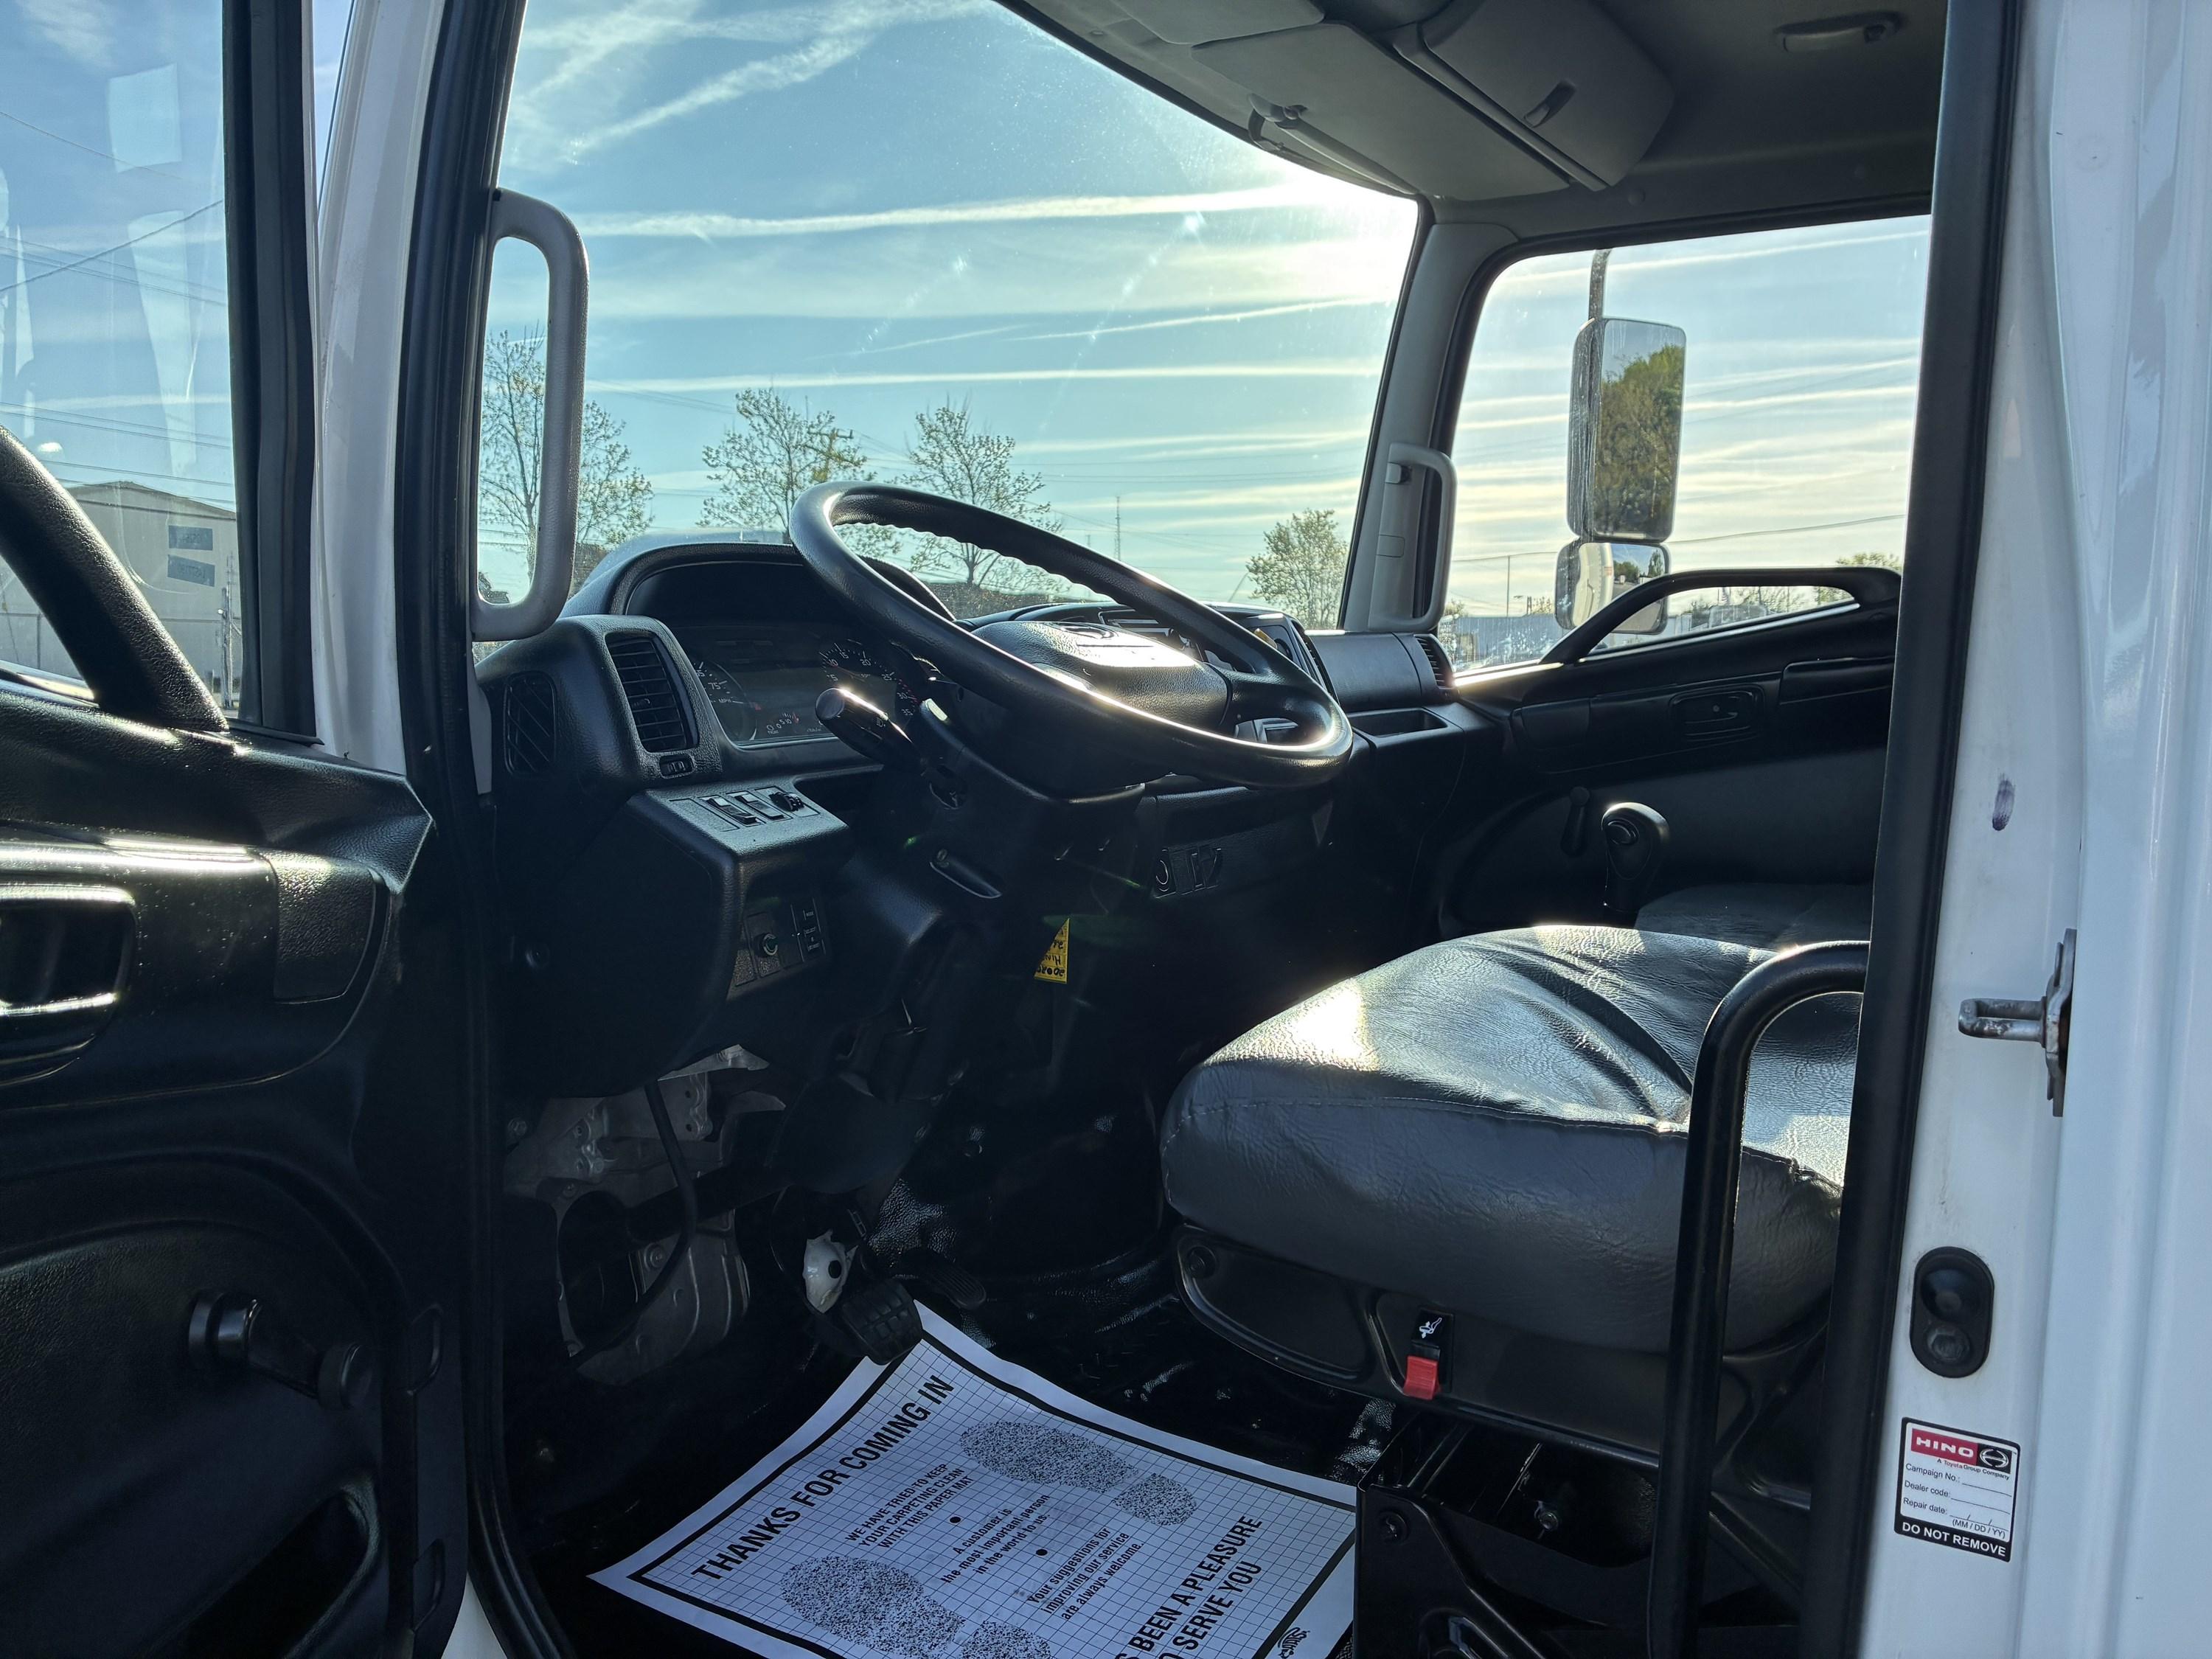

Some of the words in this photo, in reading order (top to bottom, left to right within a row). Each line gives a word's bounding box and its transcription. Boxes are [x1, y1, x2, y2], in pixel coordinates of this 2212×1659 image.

[691, 1507, 801, 1579] THANKS
[790, 1470, 850, 1507] FOR
[839, 1402, 931, 1470] COMING
[918, 1375, 954, 1405] IN
[1905, 1463, 1943, 1480] Campaign
[1916, 1436, 1974, 1458] HINO
[1944, 1460, 1963, 1469] Toyota
[1964, 1464, 1980, 1473] Group
[1982, 1468, 2010, 1481] Company
[845, 1528, 866, 1542] WE
[862, 1508, 889, 1529] HAVE
[886, 1488, 916, 1509] TRIED
[911, 1478, 929, 1489] TO
[925, 1464, 949, 1480] KEEP
[858, 1525, 890, 1547] YOUR
[886, 1486, 937, 1526] CARPETING
[933, 1468, 965, 1488] CLEAN
[878, 1527, 908, 1548] WITH
[902, 1512, 929, 1528] THIS
[924, 1489, 956, 1512] PAPER
[952, 1475, 974, 1491] MAT
[1903, 1498, 1927, 1510] Repair
[1929, 1504, 1947, 1515] date:
[1905, 1481, 1928, 1492] Dealer
[1930, 1486, 1951, 1498] code:
[940, 1570, 961, 1583] the
[959, 1550, 984, 1570] most
[1020, 1495, 1051, 1519] person
[962, 1515, 1003, 1548] customer
[998, 1509, 1012, 1517] is
[973, 1565, 989, 1574] in
[984, 1552, 1003, 1565] the
[1001, 1531, 1027, 1552] world
[1023, 1524, 1036, 1533] to
[1034, 1514, 1051, 1524] us.
[1181, 1515, 1263, 1591] PLEASURE
[1902, 1522, 1921, 1534] DO
[1924, 1527, 1950, 1542] NOT
[1952, 1534, 2006, 1557] REMOVE
[1975, 1524, 1986, 1533] DD
[1027, 1585, 1053, 1604] Your
[1050, 1539, 1099, 1585] suggestions
[1095, 1528, 1111, 1540] for
[1041, 1573, 1089, 1614] improving
[1085, 1559, 1102, 1573] our
[1099, 1532, 1130, 1559] service
[1061, 1604, 1079, 1620] are
[1077, 1576, 1108, 1605] always
[1105, 1543, 1144, 1577] welcome.
[1128, 1605, 1183, 1652] BEEN
[1170, 1593, 1196, 1607] A
[1172, 1595, 1234, 1650] SERVE
[1217, 1561, 1262, 1593] YOU
